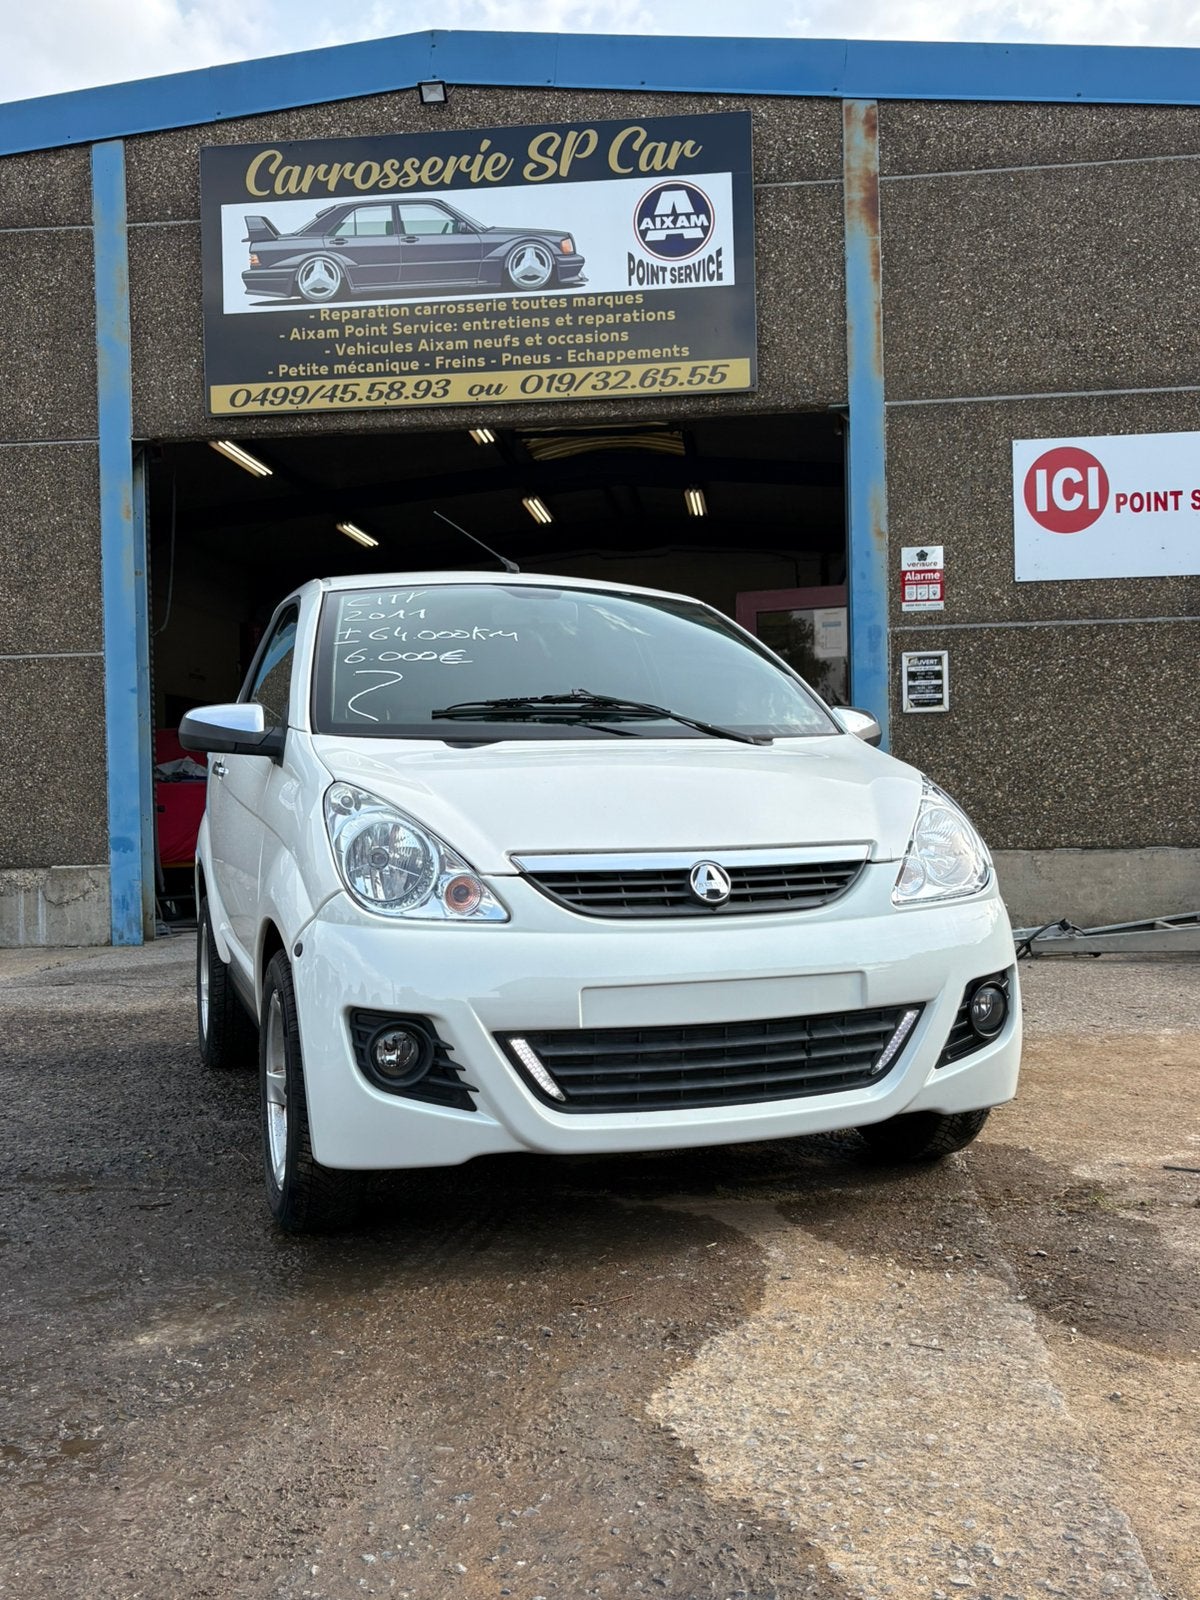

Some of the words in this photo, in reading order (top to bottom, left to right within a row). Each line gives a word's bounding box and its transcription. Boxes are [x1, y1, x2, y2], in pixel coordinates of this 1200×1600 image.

[245, 139, 515, 197] Carrosserie
[523, 128, 599, 182] SP
[608, 126, 702, 174] Car
[639, 214, 709, 230] AIXAM
[627, 251, 668, 286] POINT
[669, 246, 724, 285] SERVICE
[320, 304, 410, 323] Reparation
[414, 298, 508, 317] carrosserie
[511, 295, 567, 310] toutes
[572, 292, 644, 308] marques
[289, 326, 340, 341] Aixam
[345, 323, 388, 338] Point
[392, 319, 458, 335] Service:
[462, 312, 550, 331] entretiens
[555, 312, 571, 326] et
[577, 308, 676, 327] reparations
[335, 340, 413, 357] Vehicules
[418, 337, 469, 352] Aixam
[473, 333, 520, 349] neufs
[524, 332, 542, 347] et
[547, 329, 629, 346] occasions
[278, 361, 330, 378] Petite
[333, 356, 420, 375] mécanique
[435, 354, 487, 370] Freins
[502, 351, 551, 366] Pneus
[567, 343, 690, 364] Echappements
[229, 378, 452, 408] 0499/45.58.93
[467, 382, 508, 397] ou
[520, 363, 730, 395] 019/32.65.55
[1035, 466, 1100, 513] ICI
[1115, 490, 1183, 513] POINT
[905, 570, 940, 581] Alarme
[343, 608, 427, 622] 2011
[909, 658, 938, 666] UVERT
